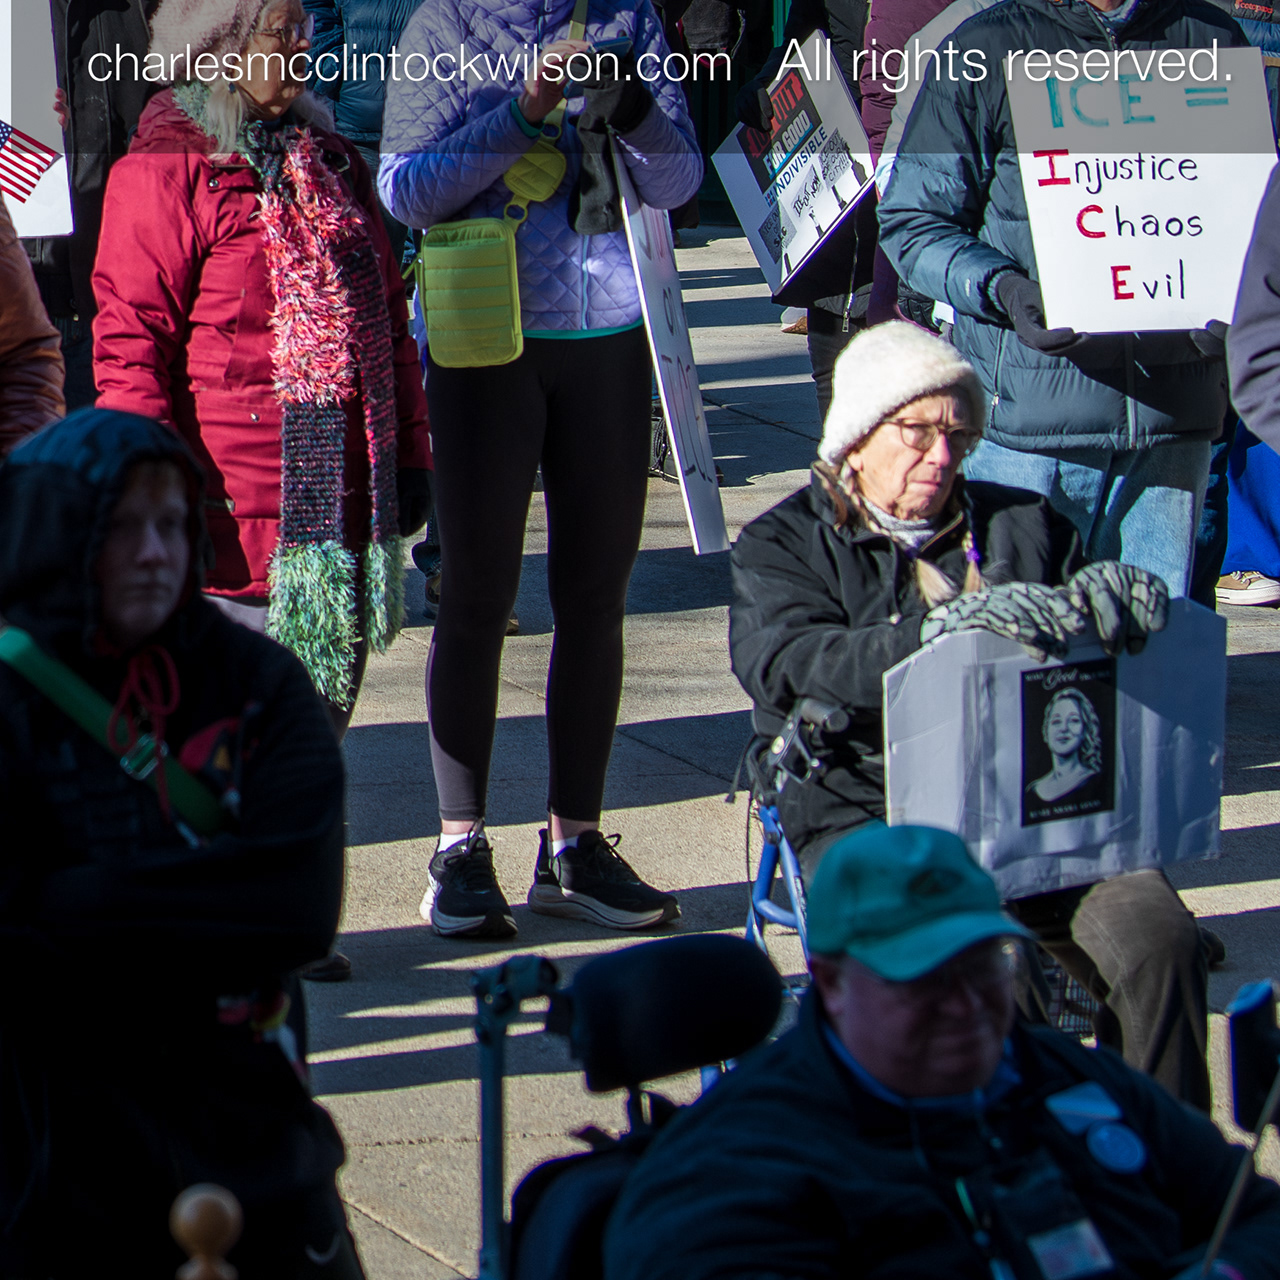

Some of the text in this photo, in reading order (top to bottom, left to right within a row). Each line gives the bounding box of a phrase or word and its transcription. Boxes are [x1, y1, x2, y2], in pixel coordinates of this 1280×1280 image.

[1046, 74, 1156, 128] ICE
[780, 109, 812, 151] GOOD
[774, 127, 828, 197] INDIVISIBLE
[1033, 149, 1198, 195] Injustice
[1076, 204, 1203, 239] Chaos
[1111, 259, 1185, 301] Evil
